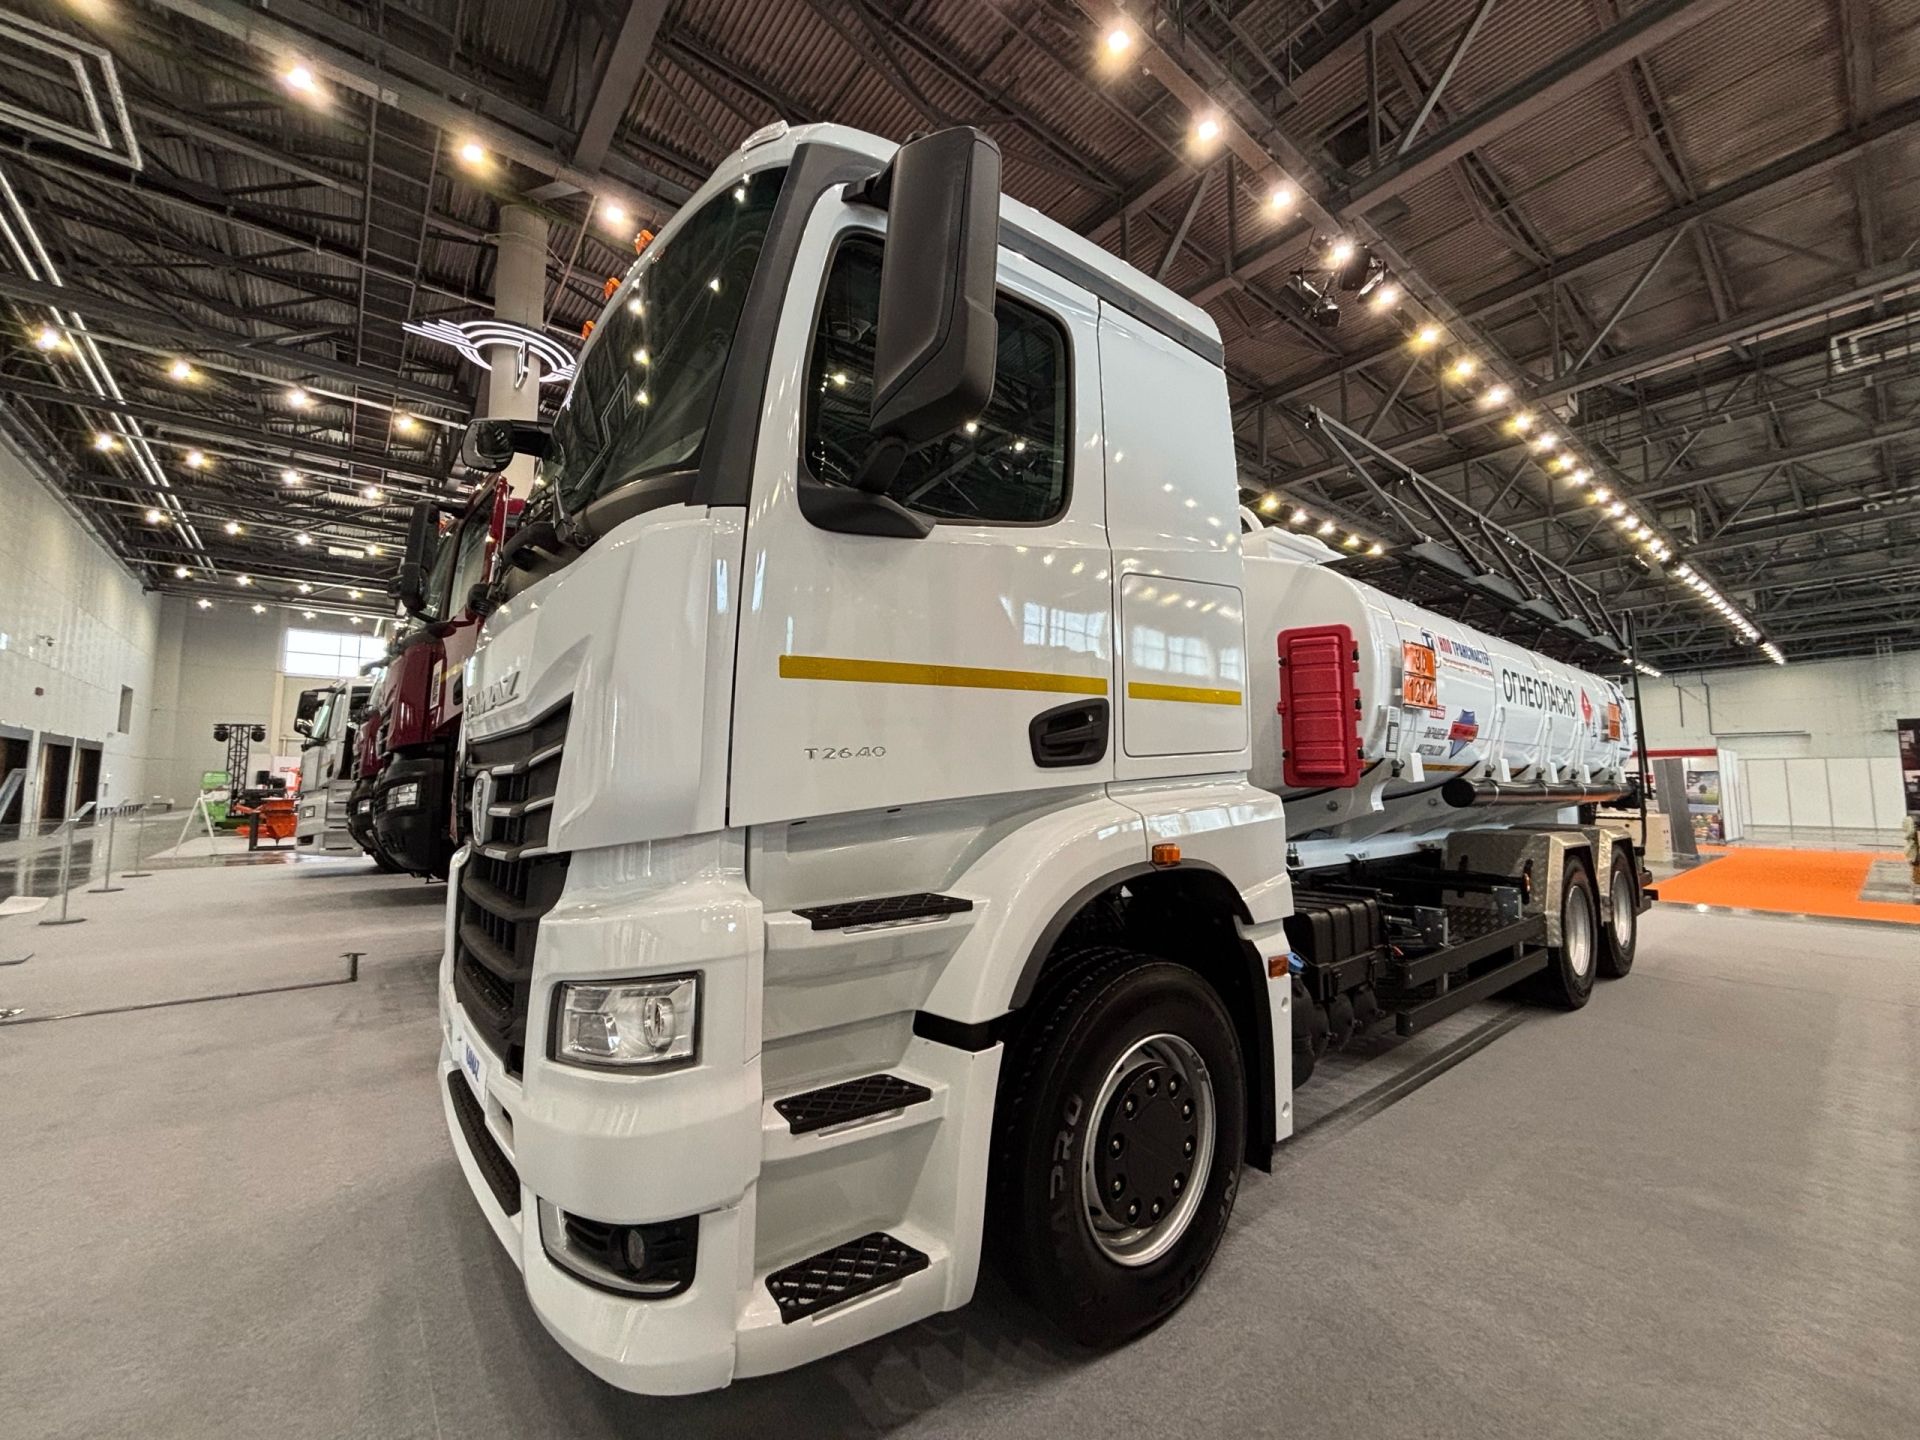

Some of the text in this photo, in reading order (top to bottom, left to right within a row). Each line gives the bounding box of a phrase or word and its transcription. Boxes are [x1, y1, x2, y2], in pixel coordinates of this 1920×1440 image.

[1408, 678, 1435, 705] 1202
[1502, 668, 1576, 718] ОГНЕОПАСНО
[803, 746, 887, 761] T2640
